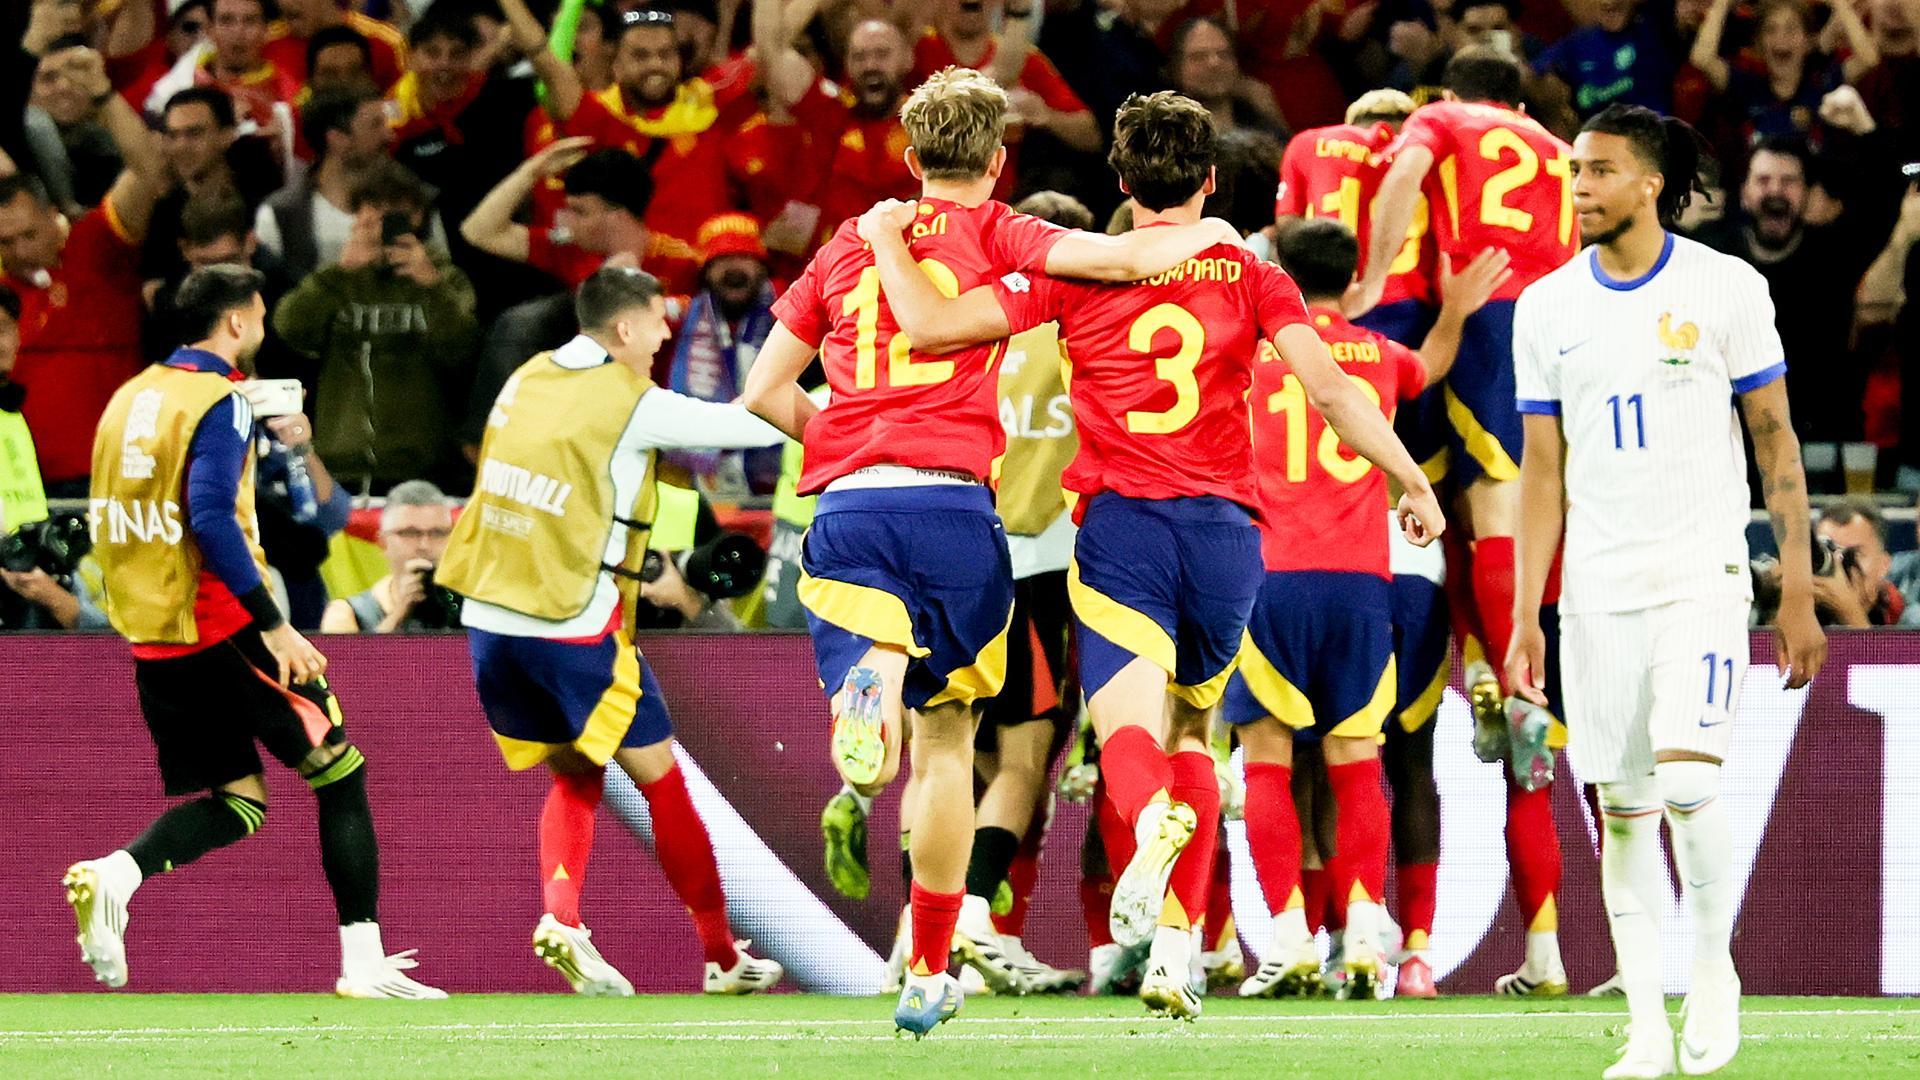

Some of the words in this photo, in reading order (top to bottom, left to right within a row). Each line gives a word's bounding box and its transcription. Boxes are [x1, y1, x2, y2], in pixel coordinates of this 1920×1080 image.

[843, 258, 960, 389] 12
[1126, 302, 1206, 435] 3
[1606, 393, 1646, 450] 11
[1702, 652, 1733, 713] 11
